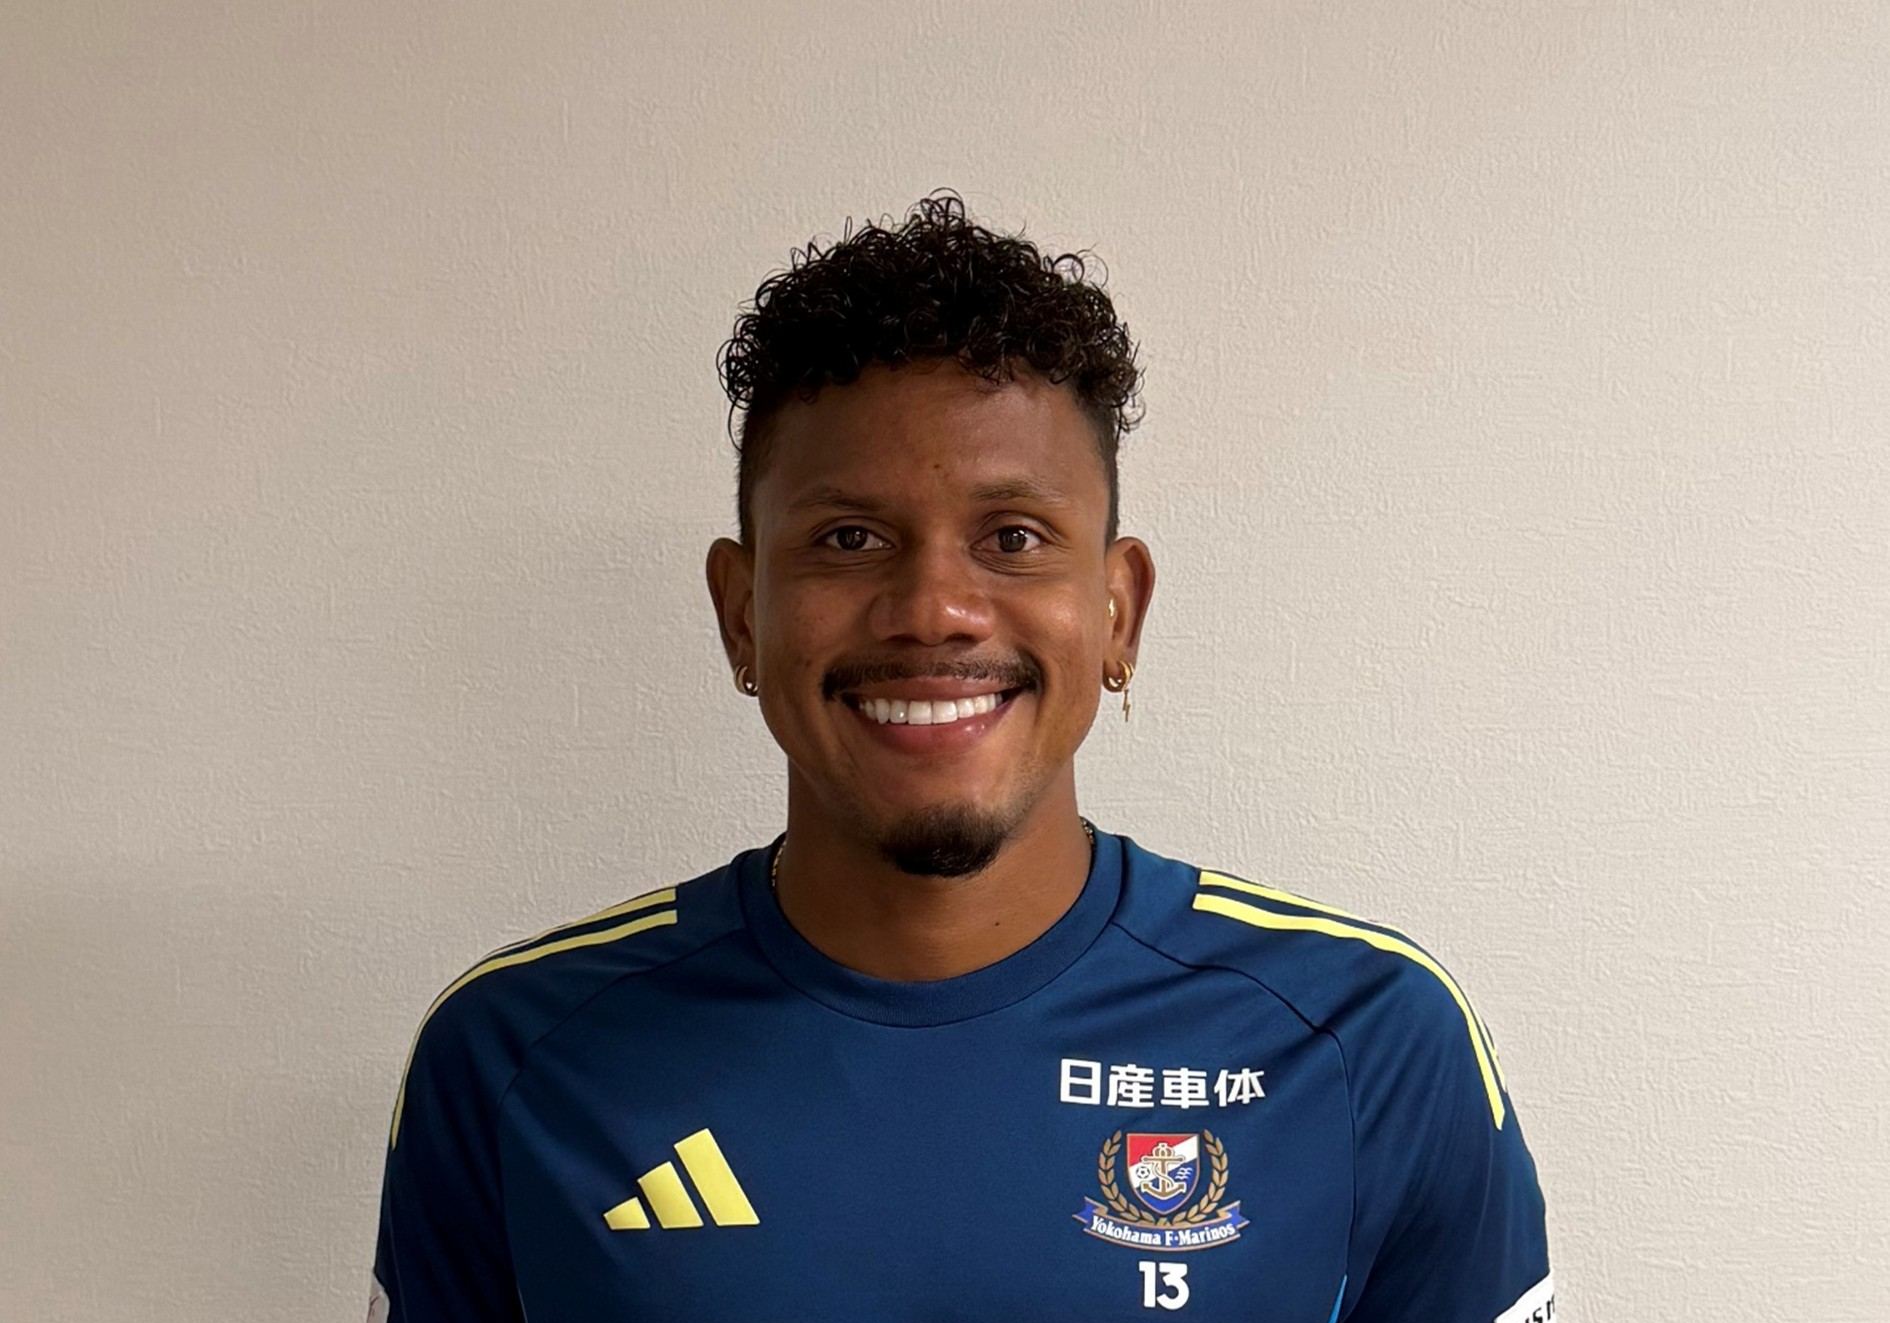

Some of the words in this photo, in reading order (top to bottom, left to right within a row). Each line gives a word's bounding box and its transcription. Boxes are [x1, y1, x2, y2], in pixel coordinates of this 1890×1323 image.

[1060, 1058, 1265, 1109] 日産車体
[1090, 1215, 1162, 1246] Yokohama
[1138, 1261, 1190, 1311] 13
